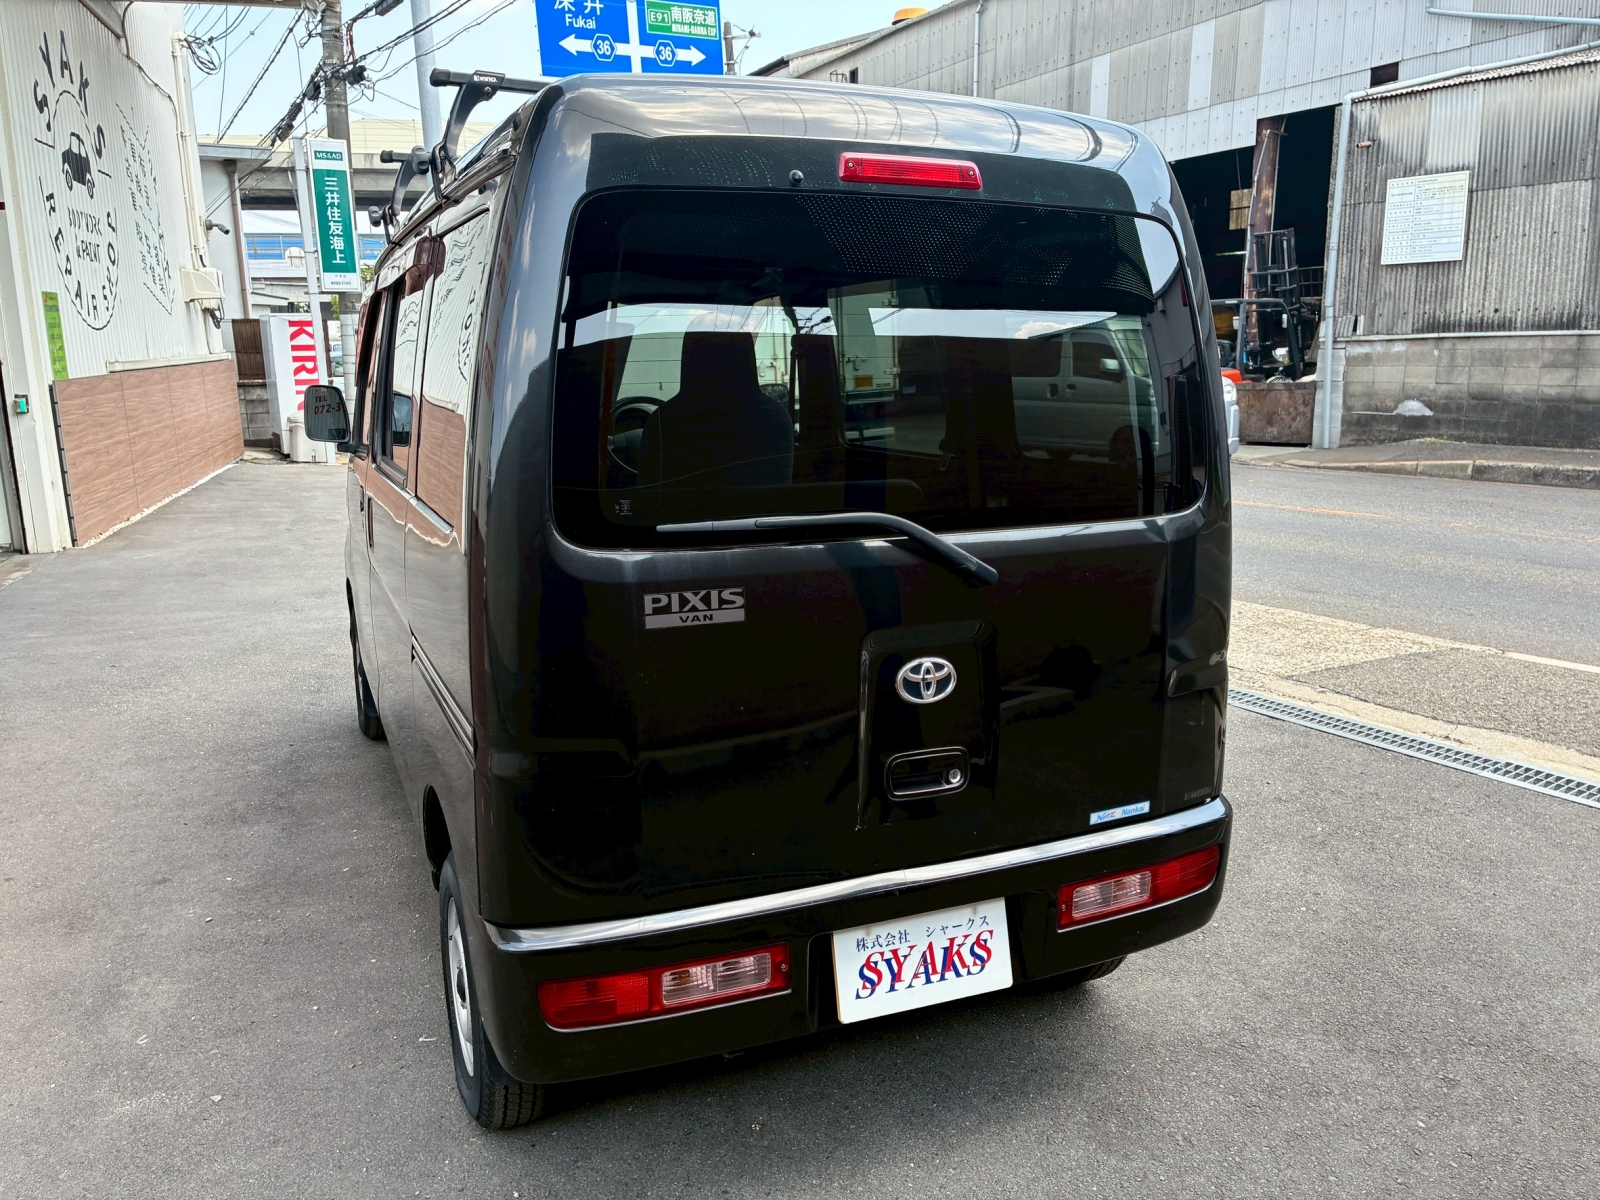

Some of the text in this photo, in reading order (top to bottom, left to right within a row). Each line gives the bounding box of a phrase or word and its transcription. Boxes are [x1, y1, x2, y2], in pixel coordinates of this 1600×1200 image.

[565, 13, 596, 29] Fukai
[650, 11, 669, 23] E91
[670, 6, 716, 26] 南阪奈道
[597, 40, 612, 56] 36
[659, 46, 673, 61] 36
[33, 29, 107, 160] SYAKS
[316, 152, 343, 160] MS&AD
[324, 177, 347, 264] 三井住友海上
[315, 395, 328, 403] TEL
[314, 403, 341, 415] 072-3
[644, 588, 745, 615] PIXIS
[679, 614, 714, 624] VAN
[1121, 804, 1146, 817] Nankai
[855, 915, 990, 953] 株式会社 シャークス
[855, 929, 994, 1000] SYAKS
